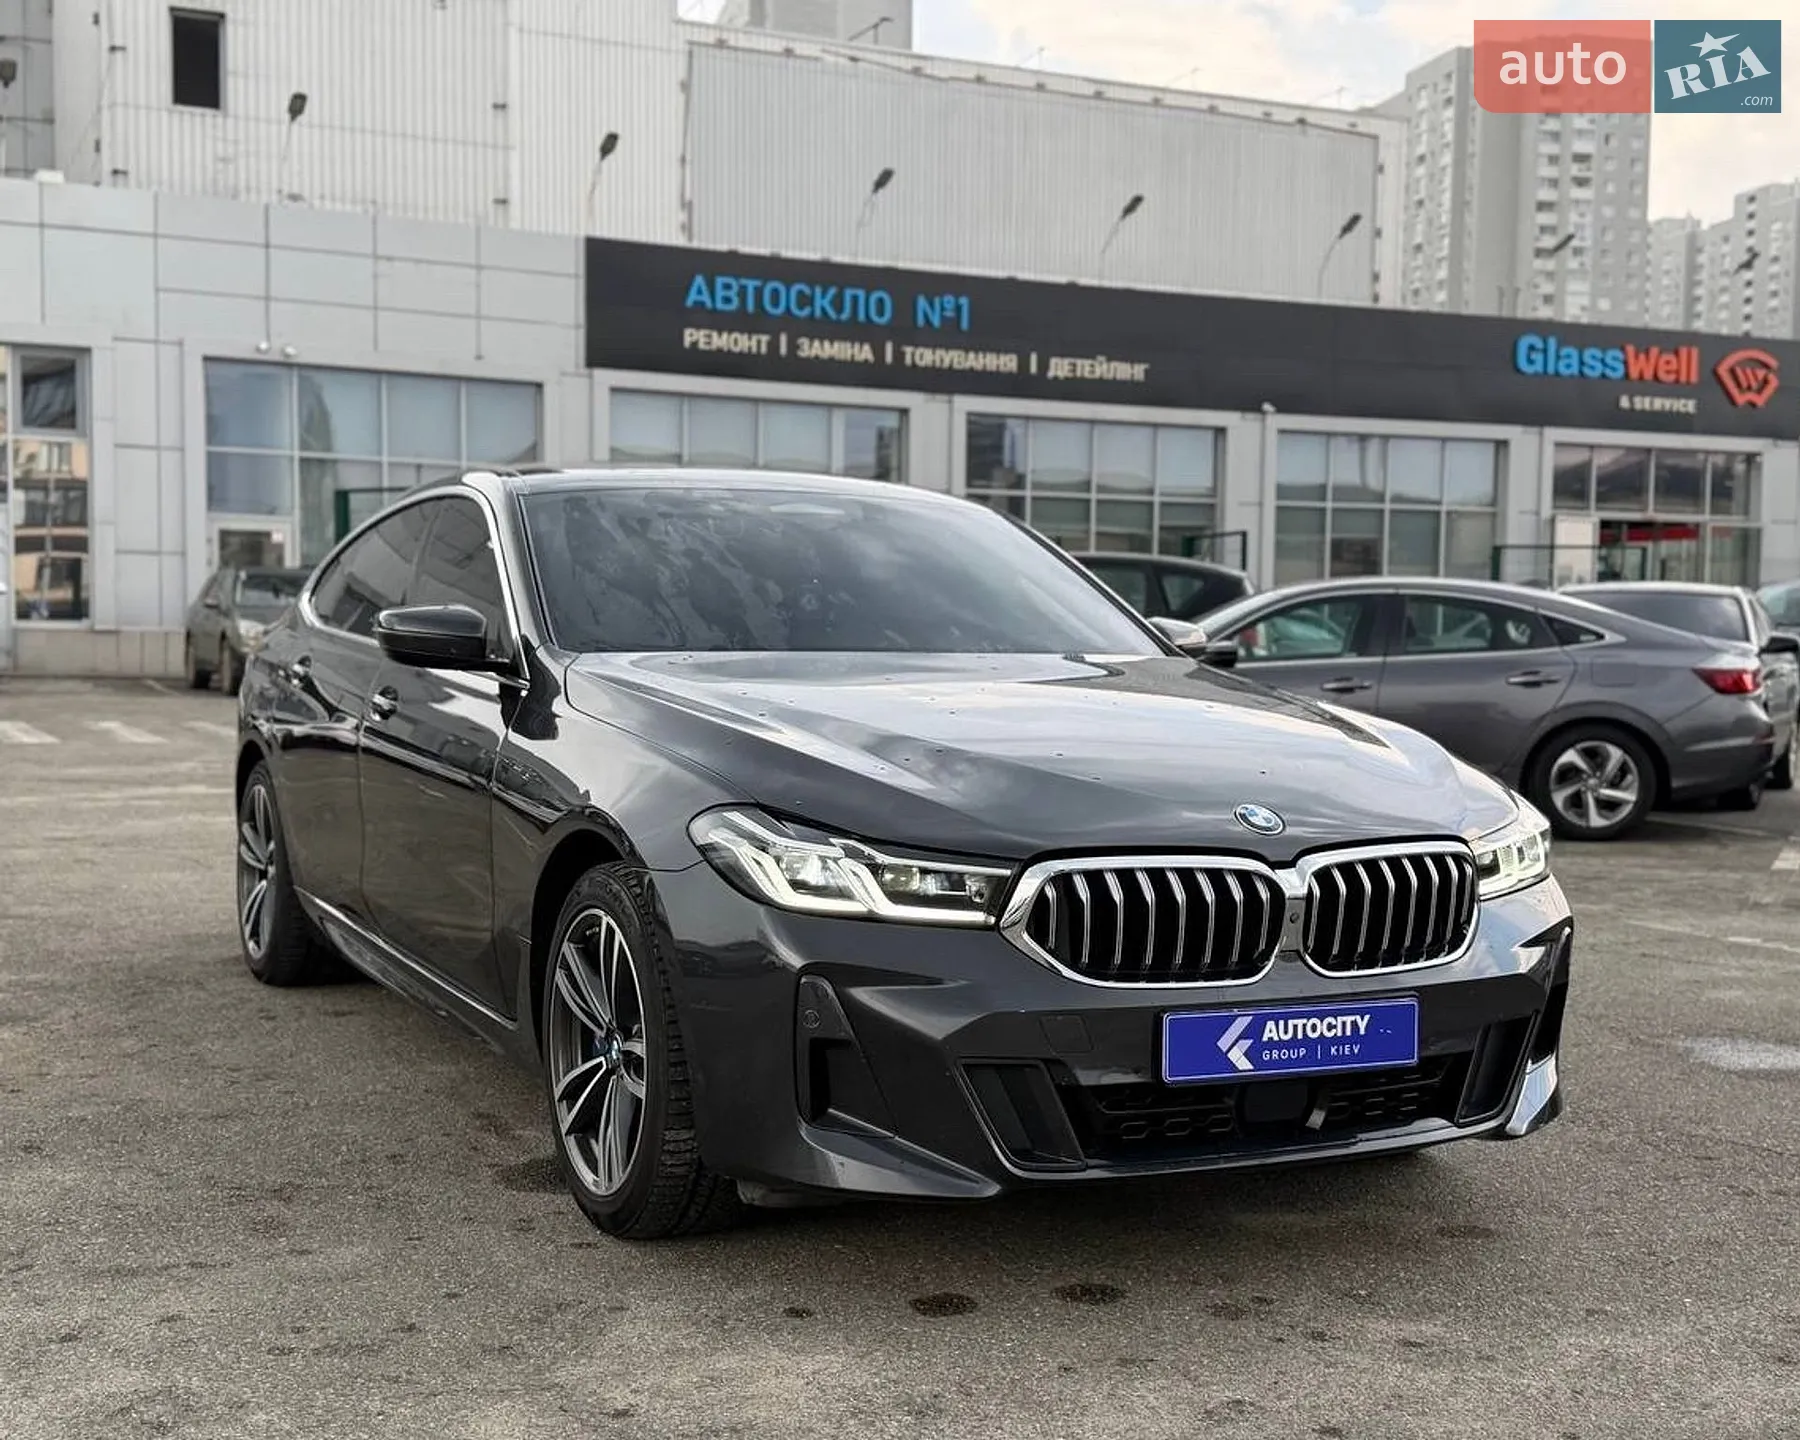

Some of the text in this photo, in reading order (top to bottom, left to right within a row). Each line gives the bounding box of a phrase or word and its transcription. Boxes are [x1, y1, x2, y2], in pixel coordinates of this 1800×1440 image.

[686, 274, 893, 325] АВТОСКЛО
[683, 328, 1149, 382] РЕМОНТ ЗАМІНА ТОНУВАННЯ ДЕТЕЙЛІНГ
[1515, 333, 1698, 384] GlassWell
[1633, 396, 1696, 413] SERVICE
[1262, 1014, 1371, 1042] AUTOCITY
[1262, 1044, 1361, 1061] GROUP KIEV
